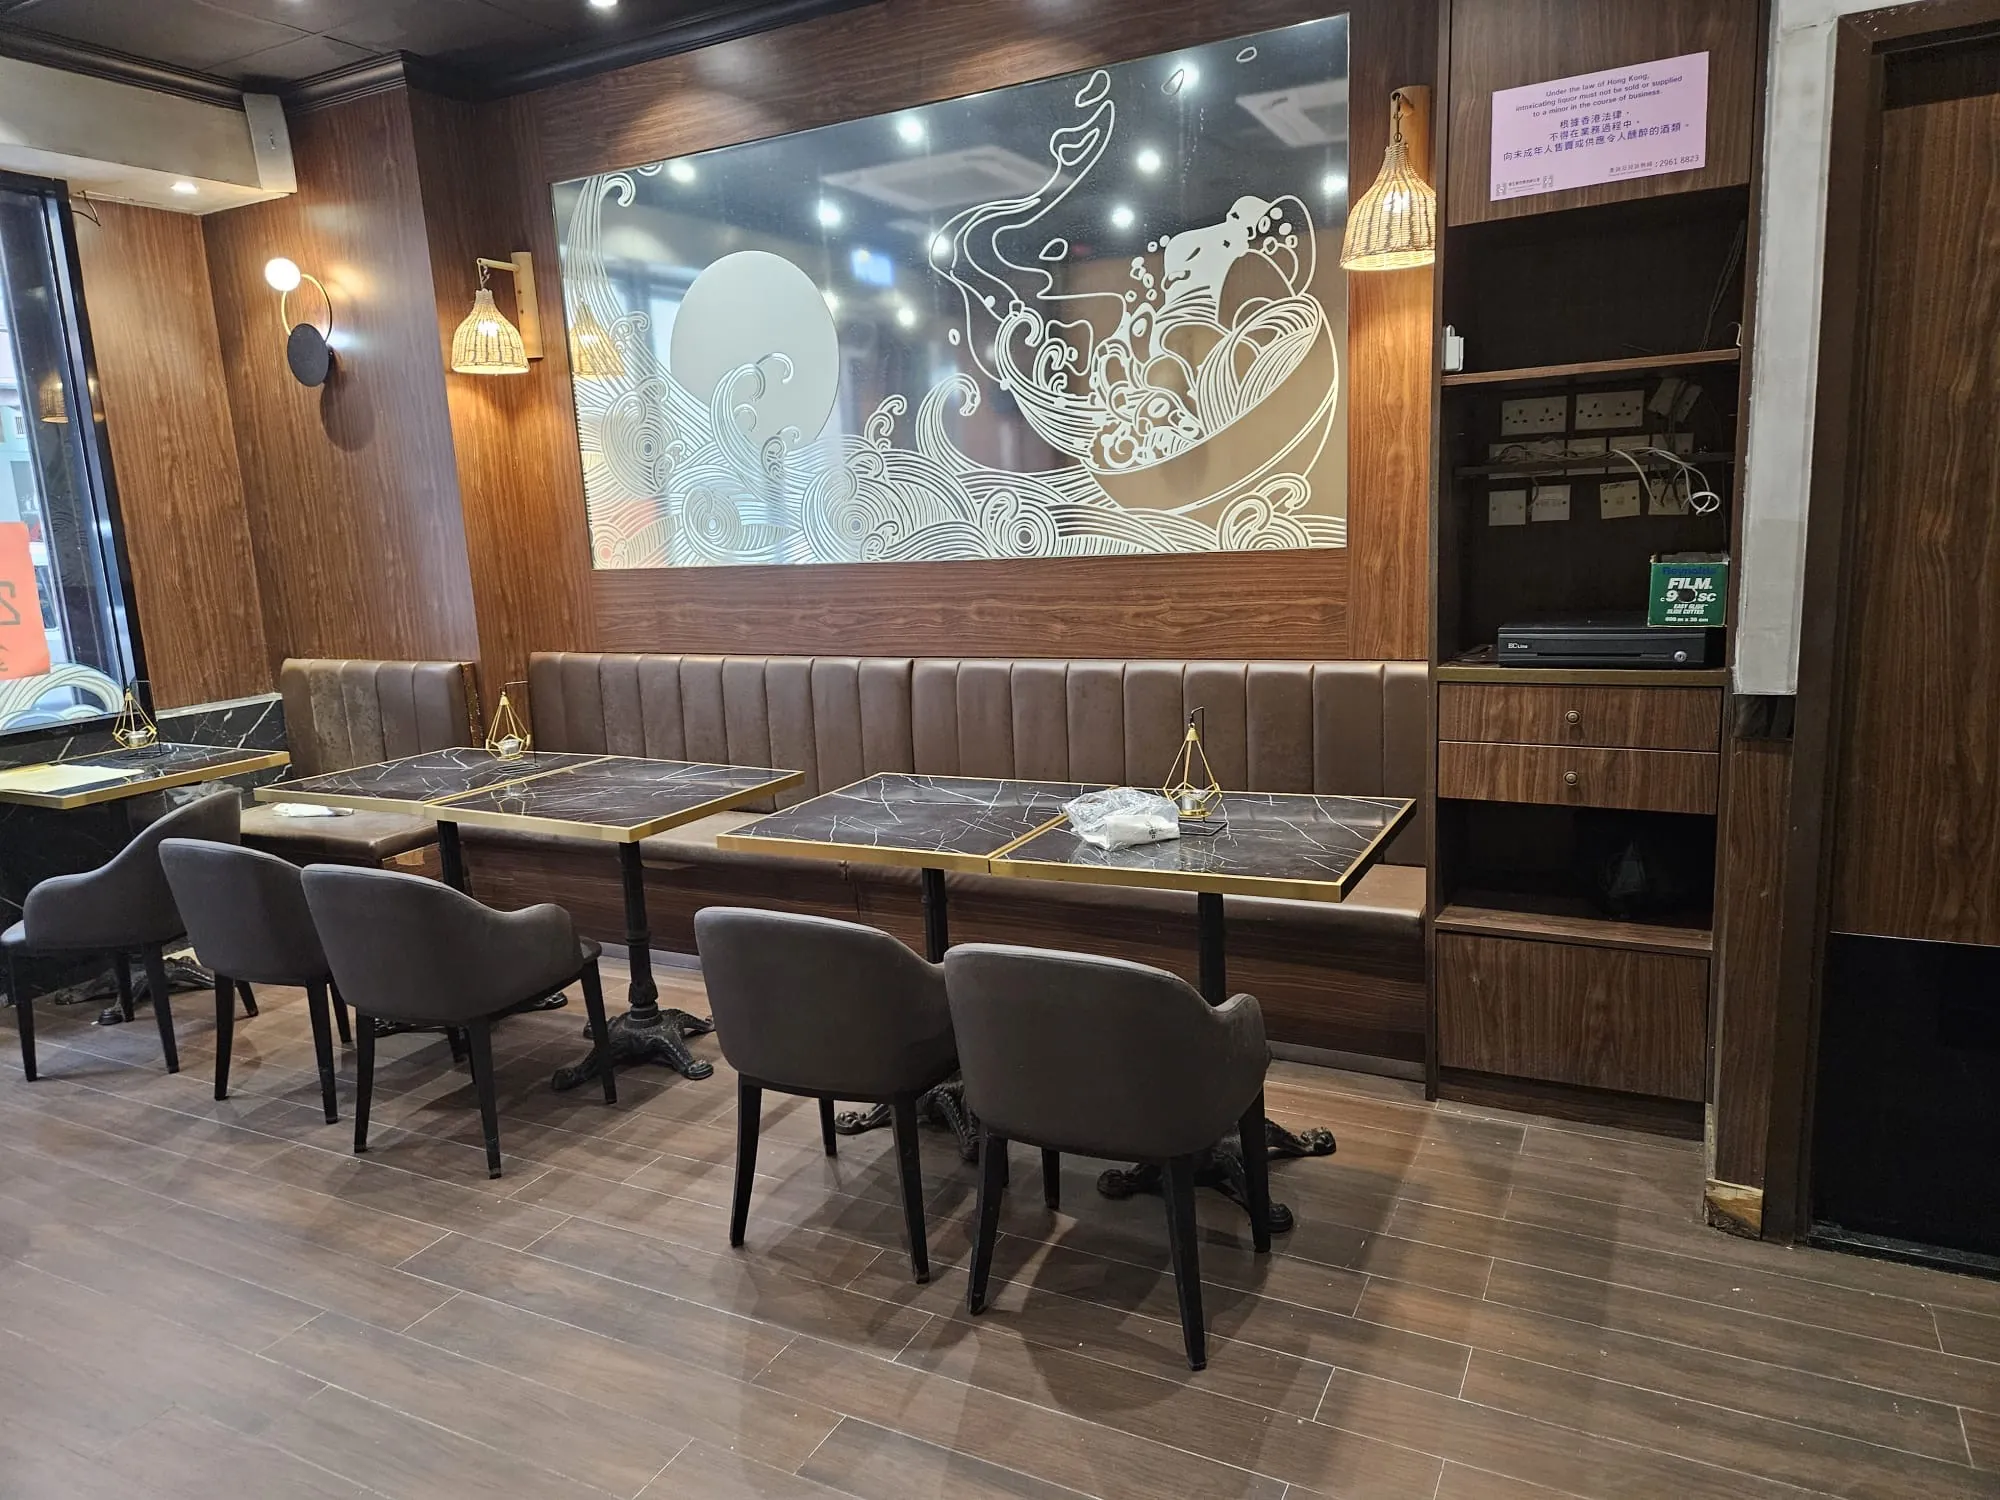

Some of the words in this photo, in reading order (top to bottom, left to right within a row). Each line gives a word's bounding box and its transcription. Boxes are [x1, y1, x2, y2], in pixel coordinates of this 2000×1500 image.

[1546, 89, 1567, 97] Under
[1607, 77, 1626, 85] Hong
[1557, 95, 1578, 104] liquor
[1652, 76, 1683, 87] supplied
[1549, 105, 1569, 114] minor
[1593, 97, 1617, 105] course
[1680, 154, 1699, 164] 8823
